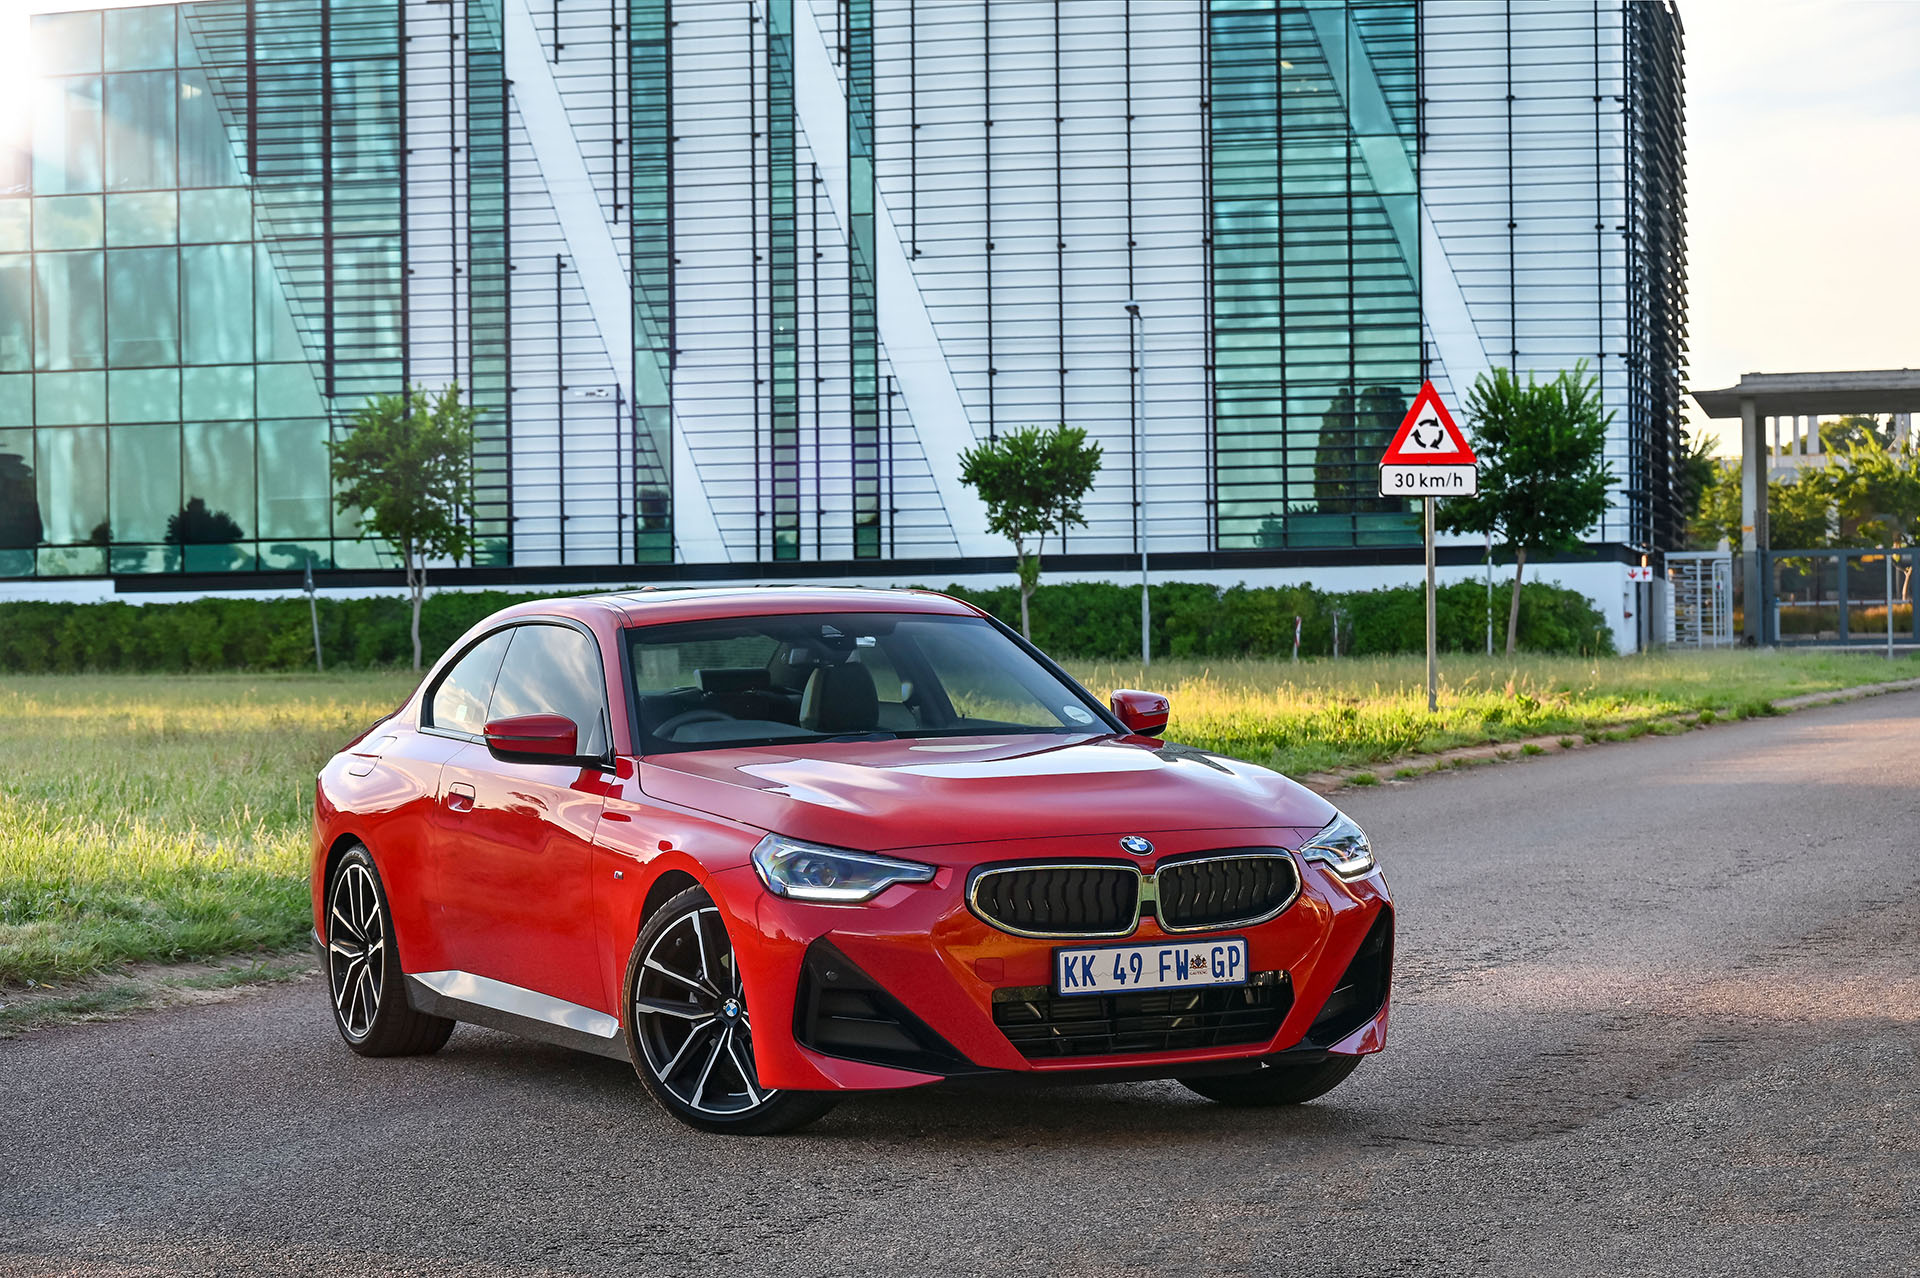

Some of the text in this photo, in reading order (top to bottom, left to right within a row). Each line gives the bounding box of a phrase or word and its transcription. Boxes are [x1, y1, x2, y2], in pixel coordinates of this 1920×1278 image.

[1395, 472, 1463, 488] 30 km/h
[1064, 945, 1241, 988] KK 49 FW GP
